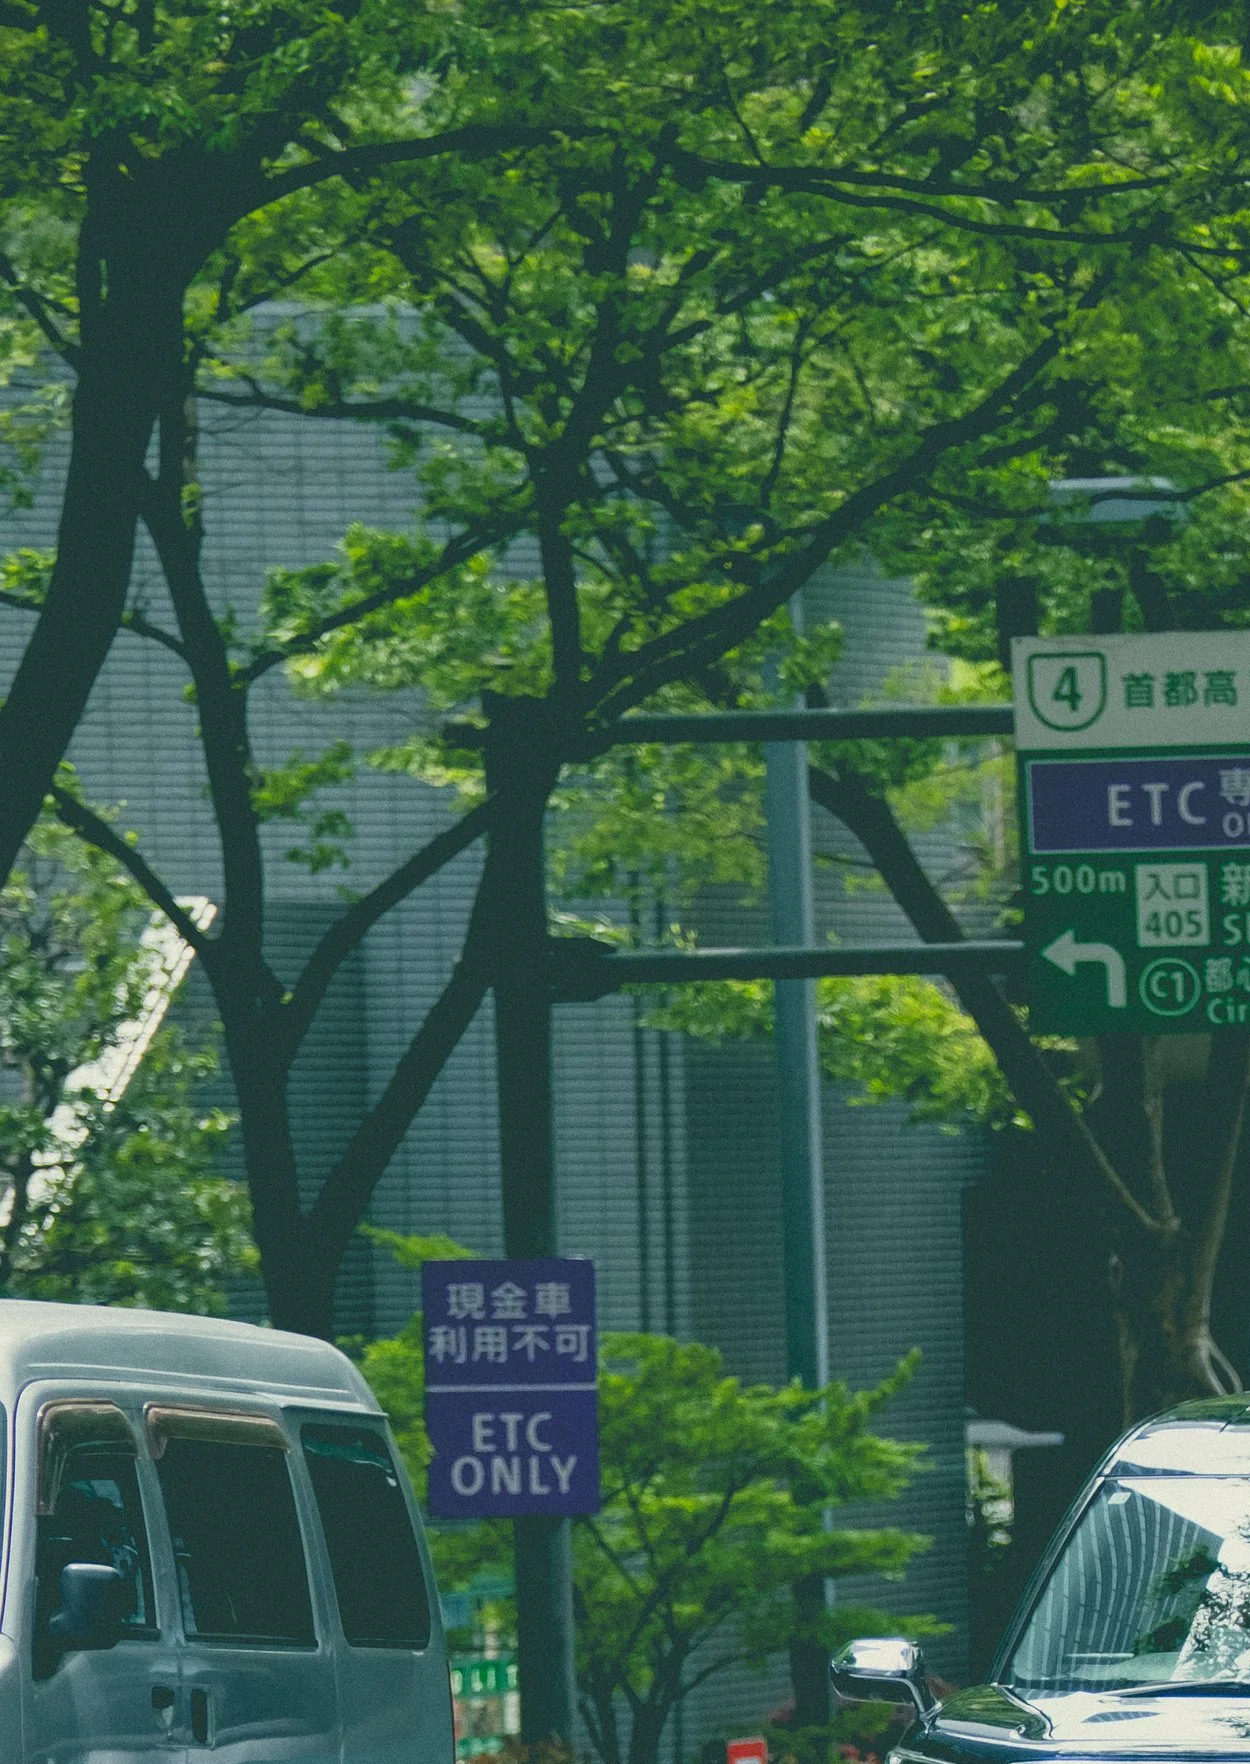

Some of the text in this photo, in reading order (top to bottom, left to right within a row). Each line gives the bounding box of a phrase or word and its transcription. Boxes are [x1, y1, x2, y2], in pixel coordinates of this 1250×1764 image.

[1052, 666, 1082, 712] 4
[1121, 670, 1238, 709] 首都高
[1107, 781, 1207, 827] ETC
[1030, 864, 1127, 895] 500m
[1143, 873, 1199, 901] 入口
[1144, 909, 1202, 938] 405
[1150, 970, 1184, 1003] C1
[446, 1281, 572, 1320] 現金車
[428, 1324, 592, 1364] 利用不可
[472, 1411, 553, 1452] ETC
[450, 1454, 578, 1496] ONLY
